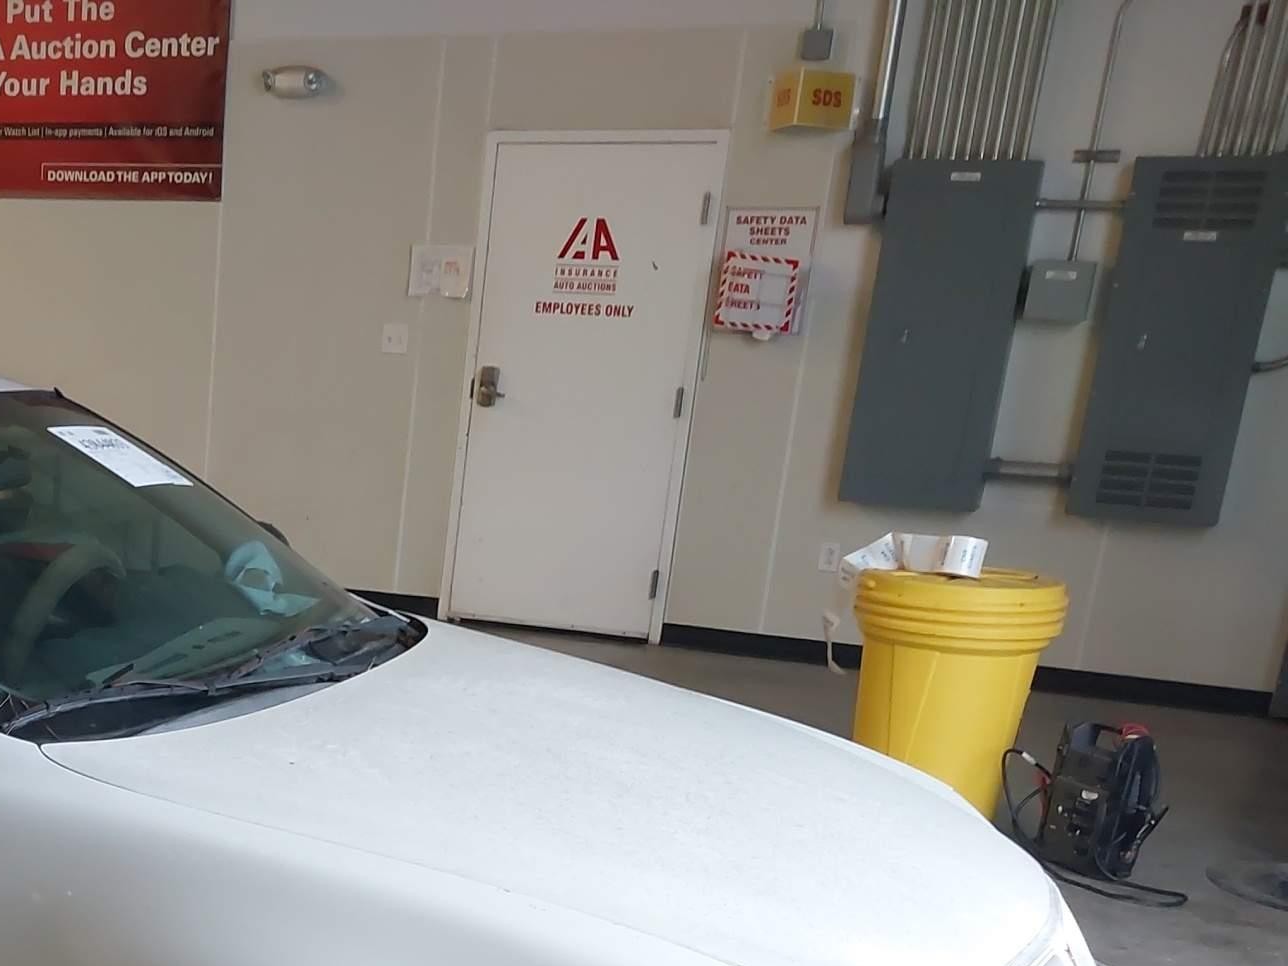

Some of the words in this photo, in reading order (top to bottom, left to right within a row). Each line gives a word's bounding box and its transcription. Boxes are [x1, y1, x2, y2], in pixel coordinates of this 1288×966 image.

[7, 0, 52, 24] Put
[65, 0, 115, 23] The
[11, 33, 116, 61] Auction
[125, 31, 220, 57] Center
[60, 69, 148, 96] Hands
[812, 88, 842, 108] SDS
[47, 170, 117, 183] DOWNLOAD
[117, 171, 139, 183] THE
[142, 171, 167, 184] APP
[168, 172, 212, 185] TODAY!
[736, 216, 777, 225] SAFETY
[779, 216, 807, 225] DATA
[749, 227, 790, 236] SHEETS
[749, 238, 787, 246] CENTER
[555, 267, 618, 278] INSURANCE
[554, 281, 574, 290] AUTO
[576, 281, 617, 292] AUCTIONS
[535, 301, 601, 316] EMPLOYEES
[604, 304, 635, 318] ONLY
